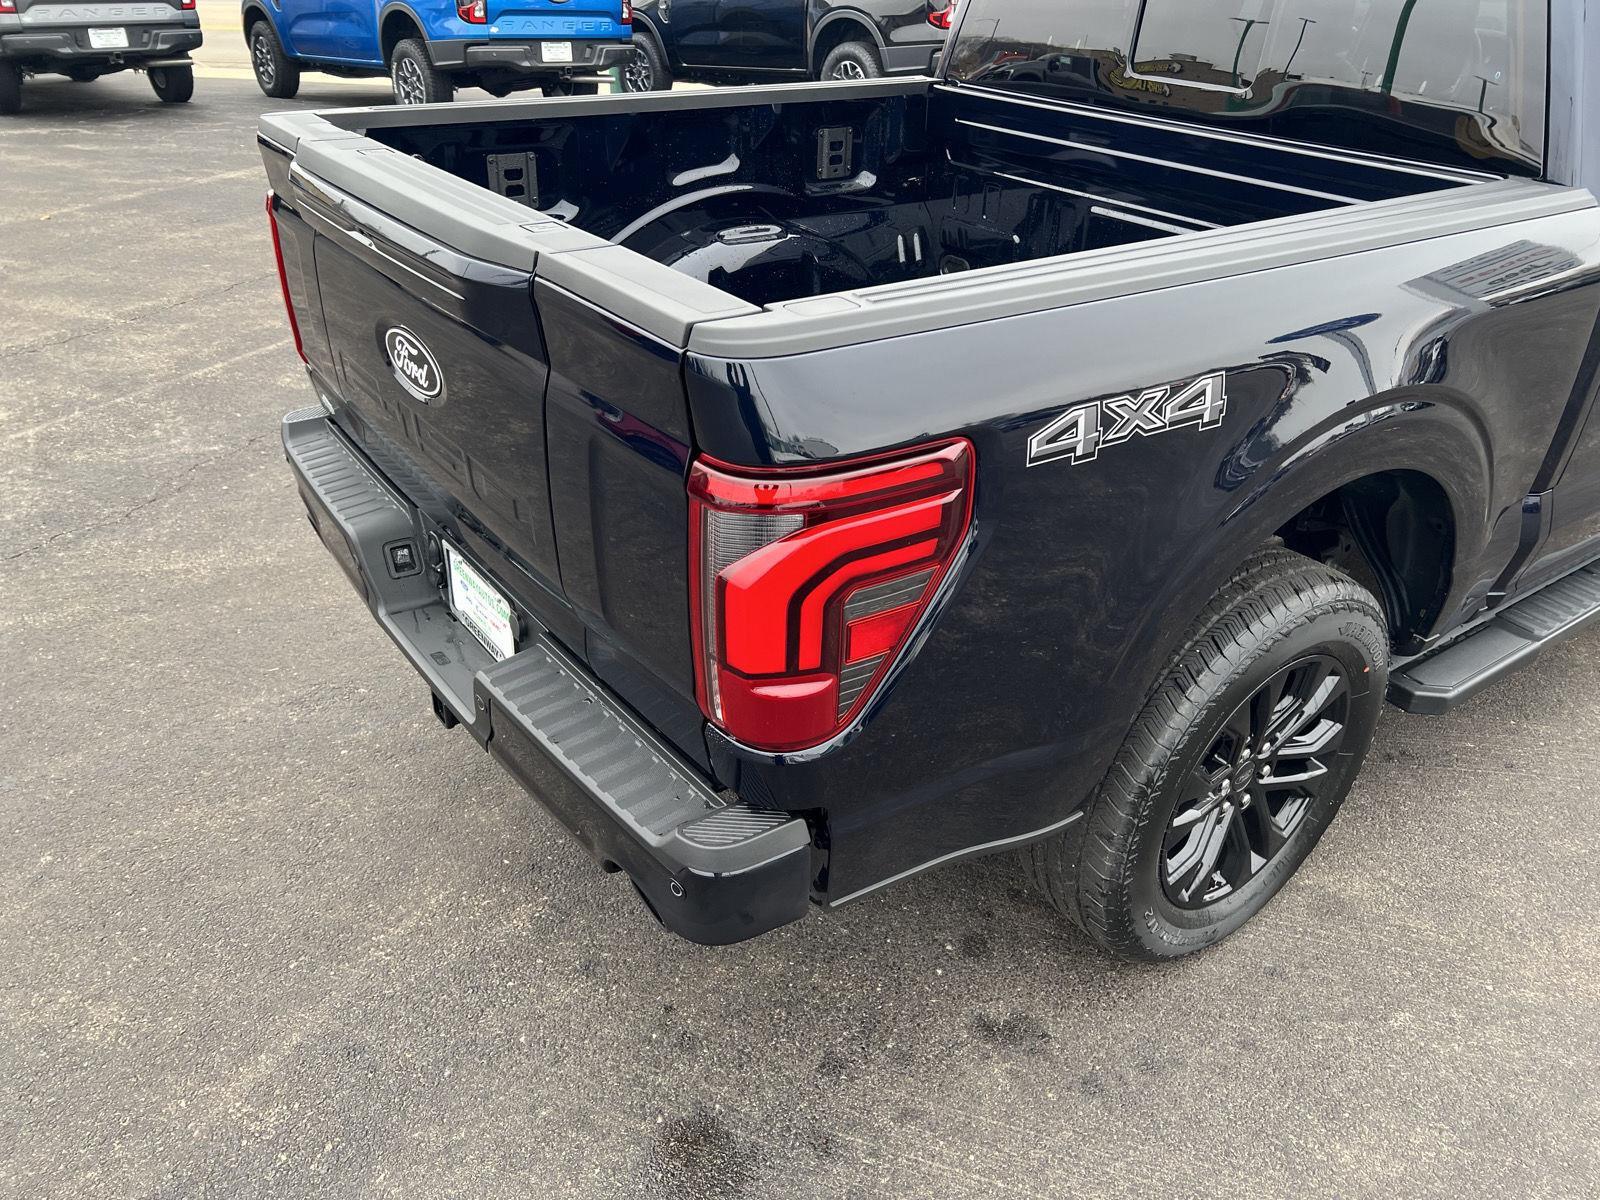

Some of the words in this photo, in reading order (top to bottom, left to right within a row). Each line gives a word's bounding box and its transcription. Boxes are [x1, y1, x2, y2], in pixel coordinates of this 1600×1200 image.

[34, 6, 170, 19] RANGER
[500, 19, 614, 32] RANGER
[394, 335, 429, 388] Ford
